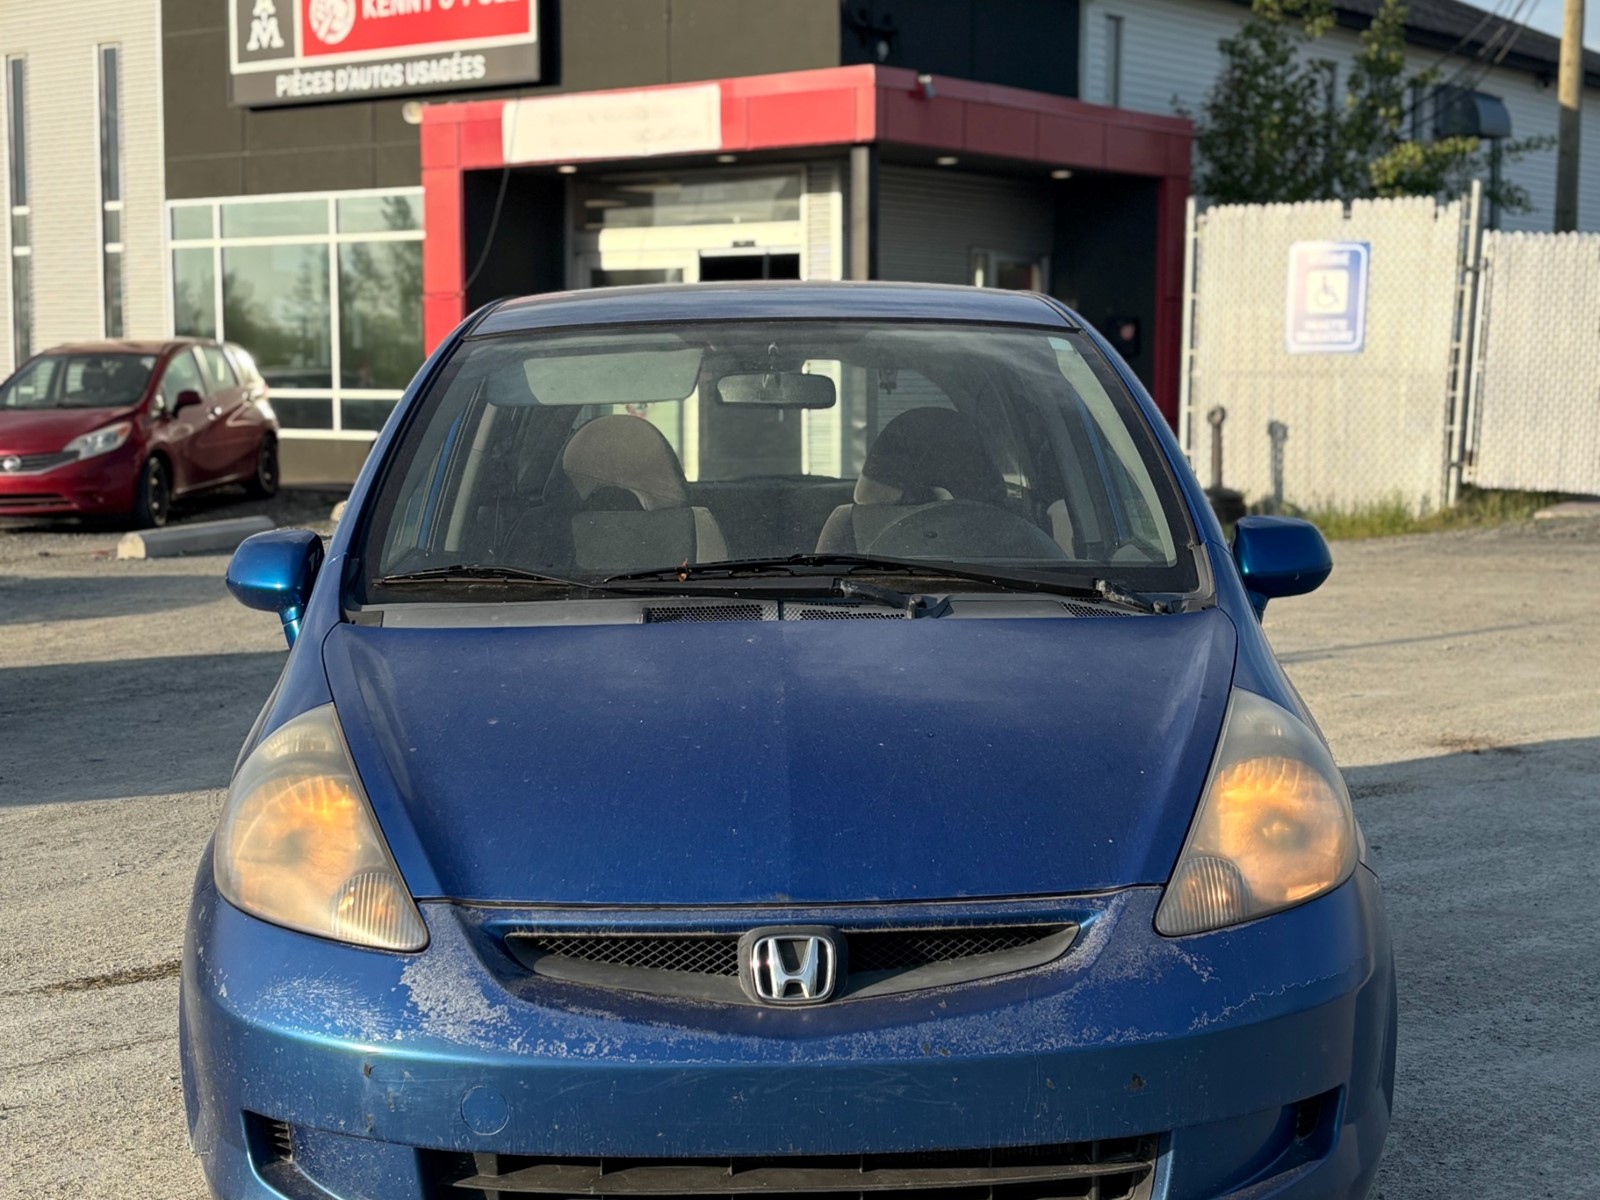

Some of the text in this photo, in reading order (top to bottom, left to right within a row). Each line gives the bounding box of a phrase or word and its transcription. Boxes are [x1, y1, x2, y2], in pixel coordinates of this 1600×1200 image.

[275, 51, 486, 98] PIÈCES D'AUTOS USAGÉES
